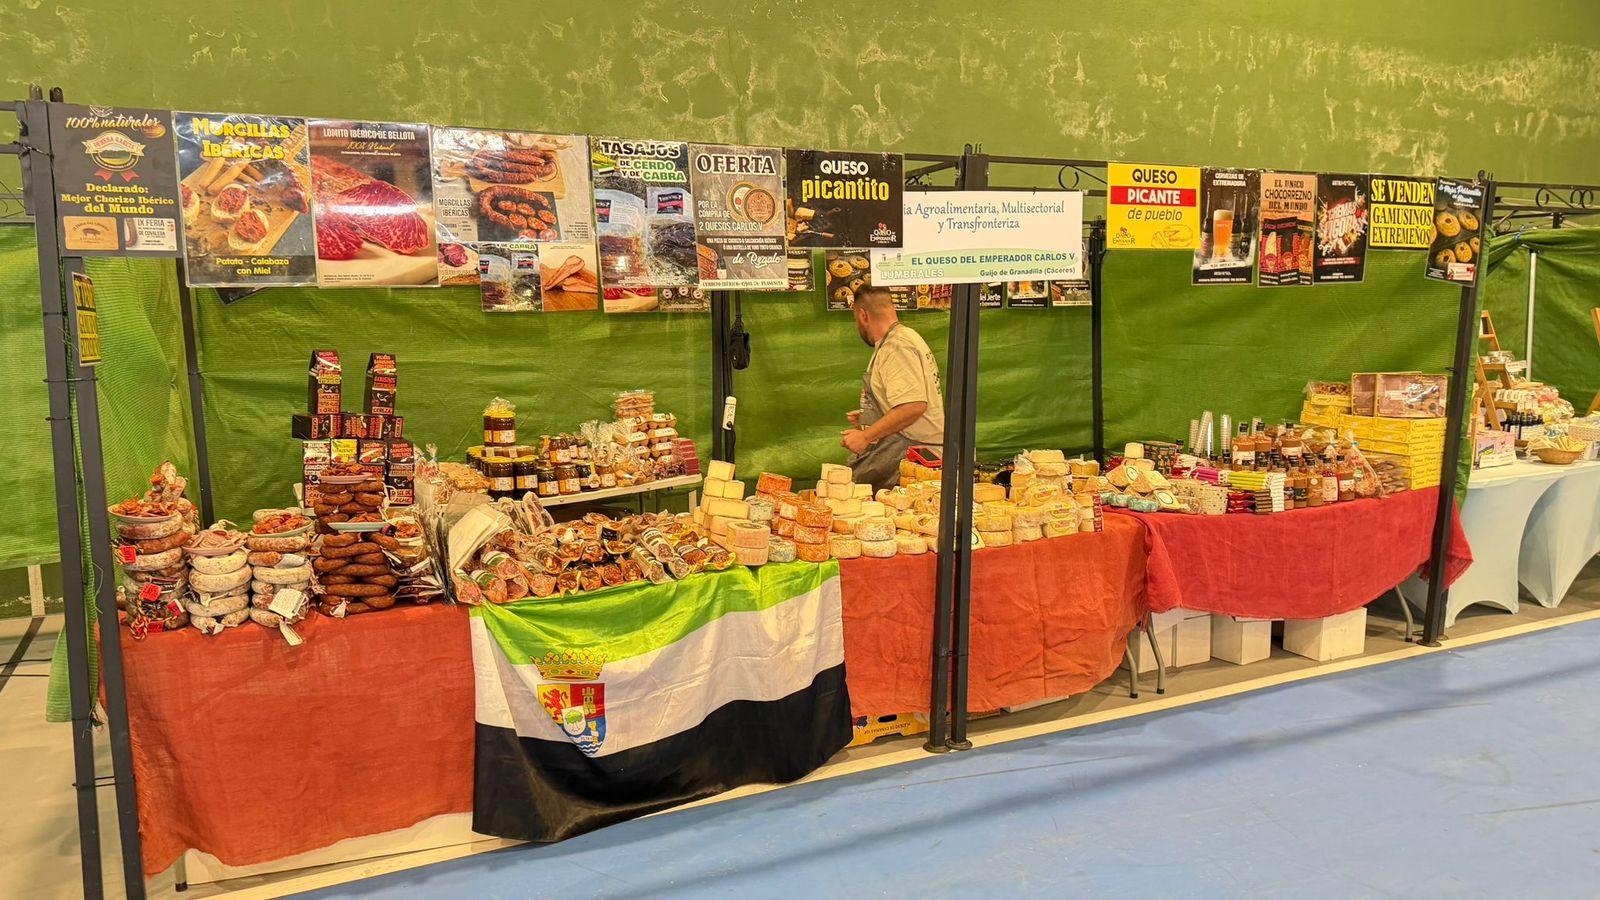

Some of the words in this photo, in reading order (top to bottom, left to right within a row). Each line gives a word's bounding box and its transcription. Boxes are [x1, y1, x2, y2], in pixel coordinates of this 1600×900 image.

[65, 116, 99, 129] 100%
[100, 113, 161, 131] naturales
[192, 118, 290, 139] MORCILLAS
[324, 128, 349, 137] LOMITO
[388, 131, 416, 140] BELLOTA
[202, 140, 286, 160] IBÉRICAS
[601, 142, 680, 157] TASAJOS
[633, 160, 675, 171] CERDO
[697, 155, 776, 174] OFERTA
[820, 160, 869, 175] QUESO
[643, 171, 686, 181] CABRA
[1132, 169, 1177, 184] QUESO
[86, 183, 149, 194] Declarado:
[802, 176, 890, 202] picantito
[1265, 189, 1312, 200] CHOCORREZNO
[1371, 179, 1386, 202] SE
[1386, 180, 1435, 204] VENDEN
[61, 194, 92, 204] Mejor
[94, 195, 136, 204] Chorizo
[138, 196, 174, 205] Ibérico
[1127, 189, 1180, 204] PICANTE
[84, 204, 106, 213] del
[108, 204, 154, 214] Mundo
[915, 201, 999, 219] Agroalimentaria,
[1002, 201, 1064, 214] Multisectorial
[1284, 202, 1307, 210] MUNDO
[1128, 208, 1142, 219] de
[1145, 210, 1182, 221] pueblo
[1373, 207, 1432, 226] GAMUSINOS
[699, 222, 704, 230] 2
[705, 222, 731, 231] QUESOS
[732, 222, 757, 231] CARLOS
[758, 222, 763, 231] V
[938, 221, 944, 233] y
[946, 216, 1020, 232] Transfronteriza
[1372, 226, 1431, 245] EXTREMEÑOS
[251, 257, 290, 265] Calabaza
[732, 253, 744, 264] de
[747, 251, 781, 268] Regalo
[912, 257, 923, 266] EL
[925, 256, 958, 265] QUESO
[960, 255, 977, 264] DEL
[979, 254, 1032, 263] EMPERADOR
[1034, 253, 1066, 261] CARLOS
[254, 266, 272, 275] Miel
[881, 269, 944, 280] LUMBRALES
[980, 270, 998, 278] Guijo
[1044, 267, 1075, 275] (Cáceres)
